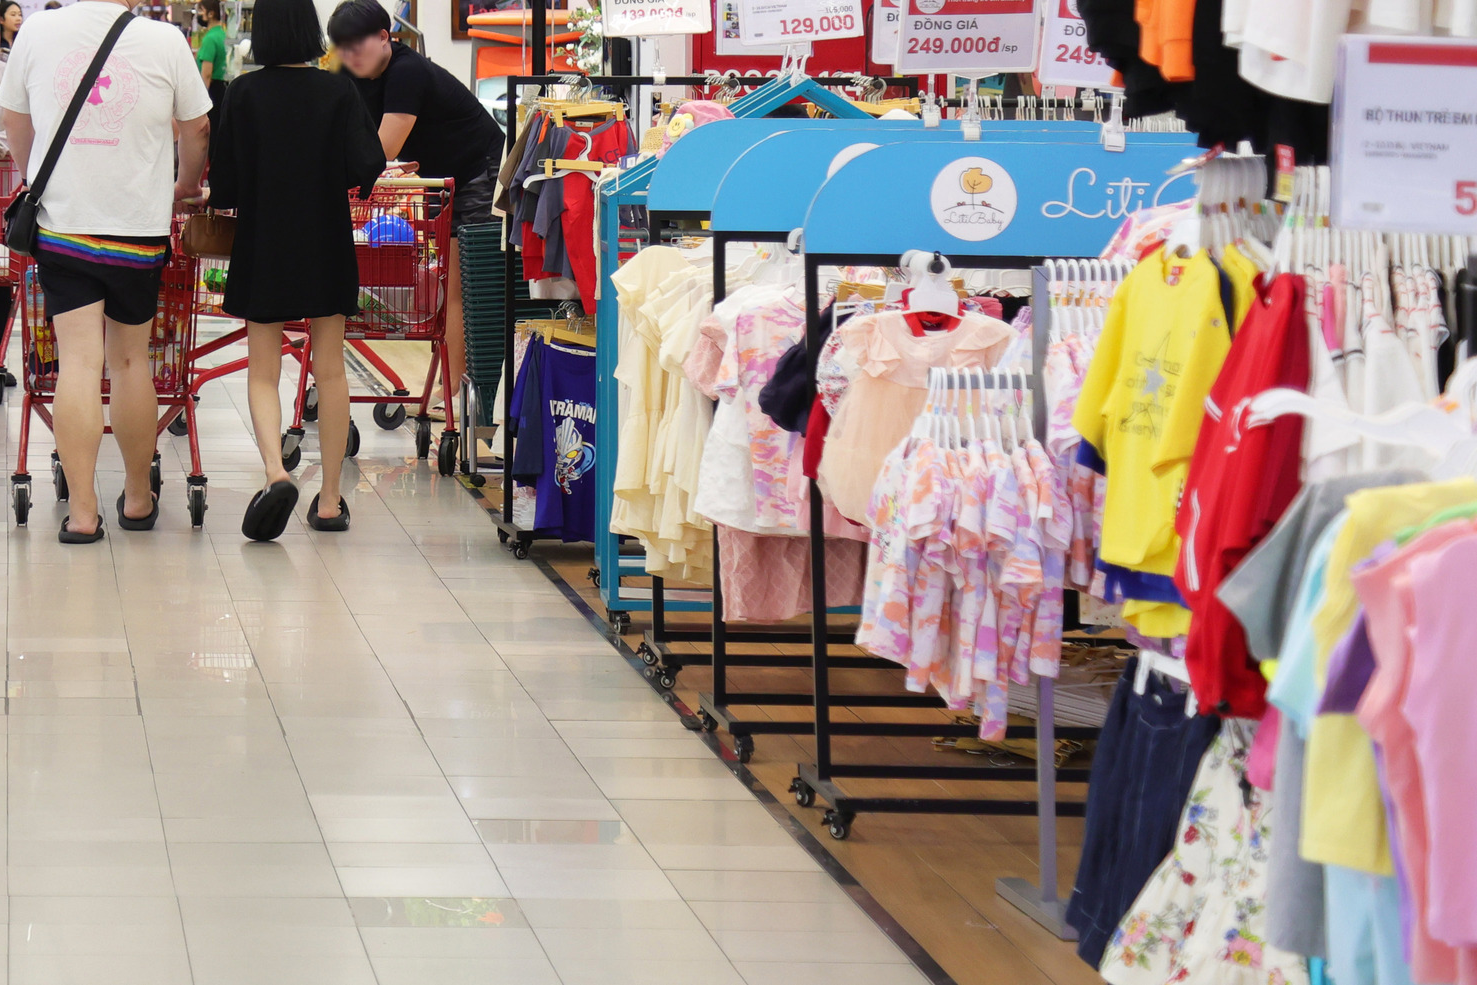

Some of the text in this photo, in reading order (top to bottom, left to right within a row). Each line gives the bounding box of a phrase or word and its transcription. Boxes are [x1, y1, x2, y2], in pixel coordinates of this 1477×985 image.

[780, 15, 855, 35] 129,000
[914, 18, 978, 30] ĐỒNG GIÁ
[907, 36, 1018, 54] 249.000đ /sp
[1387, 110, 1422, 123] THUN
